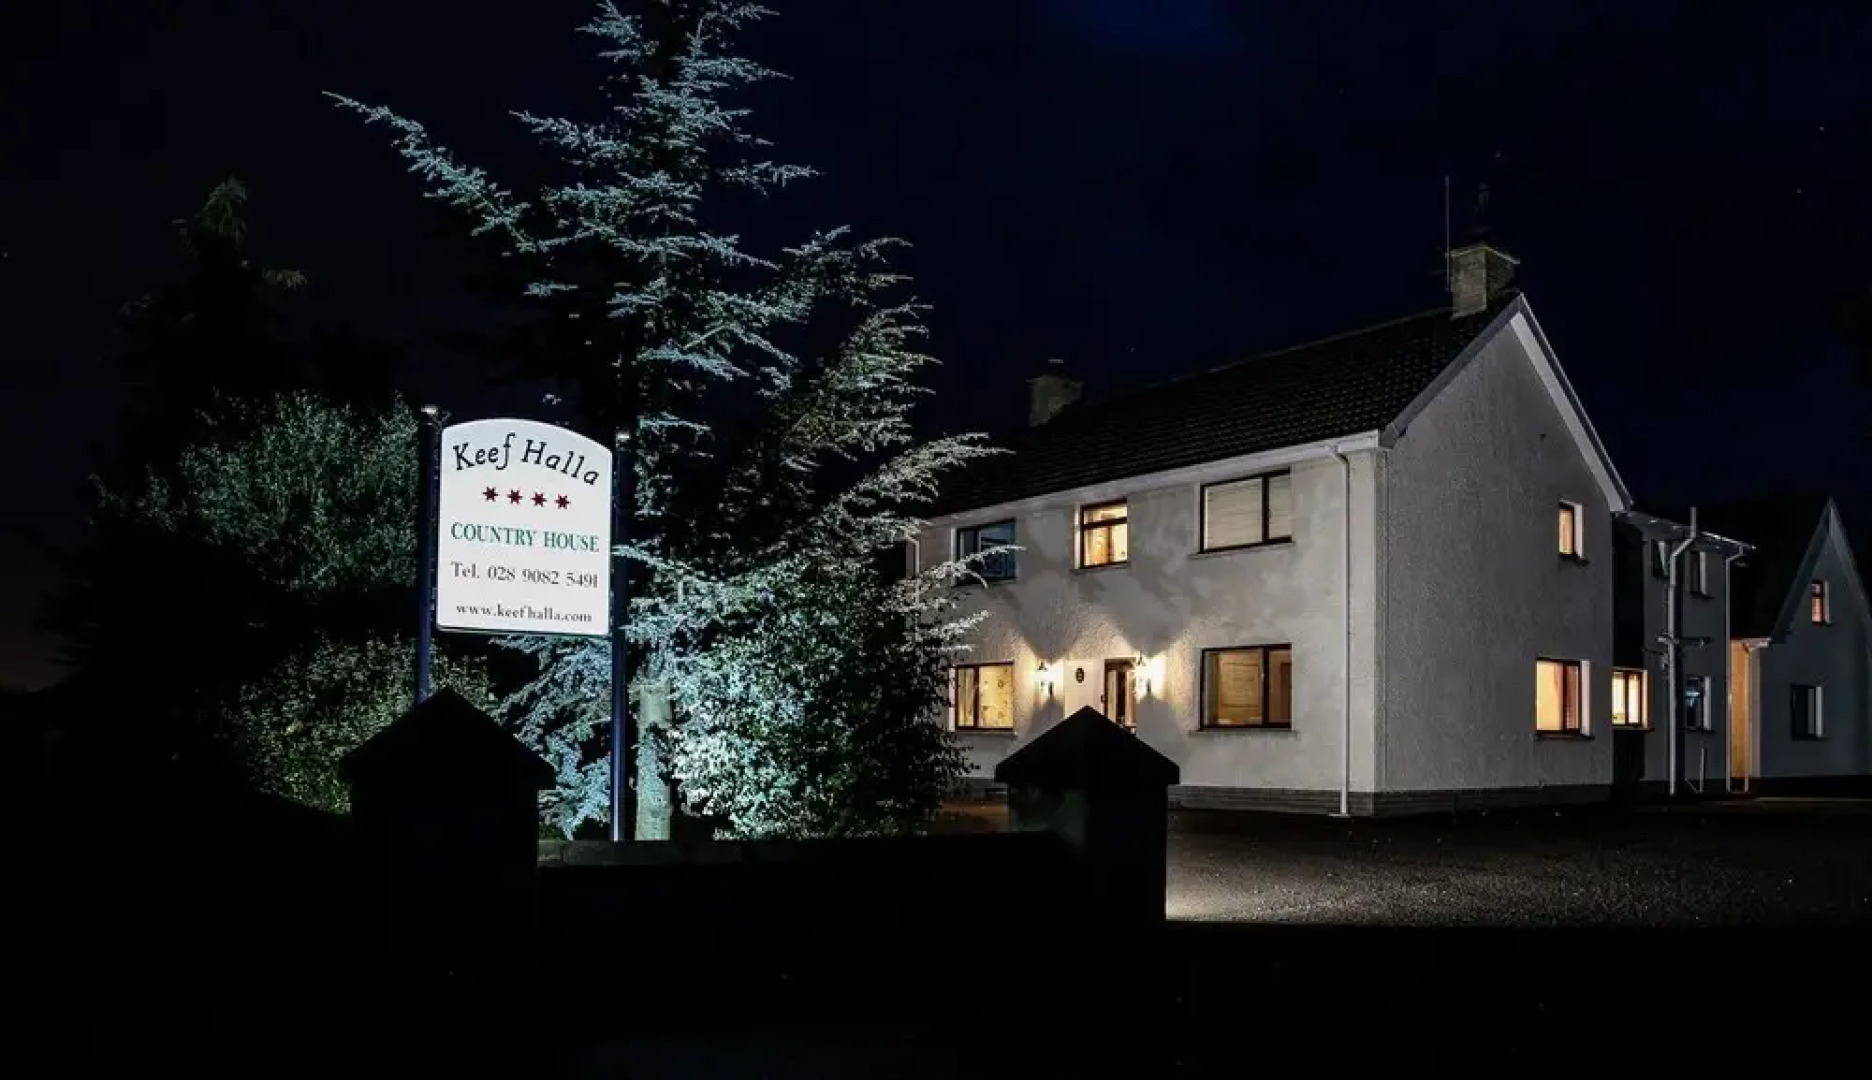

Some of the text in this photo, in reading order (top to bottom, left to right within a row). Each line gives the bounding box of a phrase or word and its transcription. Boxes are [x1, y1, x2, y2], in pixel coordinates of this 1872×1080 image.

[453, 432, 600, 485] Keef Halla
[451, 522, 600, 553] COUNTRY HOUSE
[451, 561, 599, 589] Tel. 028 9082 5491
[456, 604, 593, 623] www.keefhalla.com
